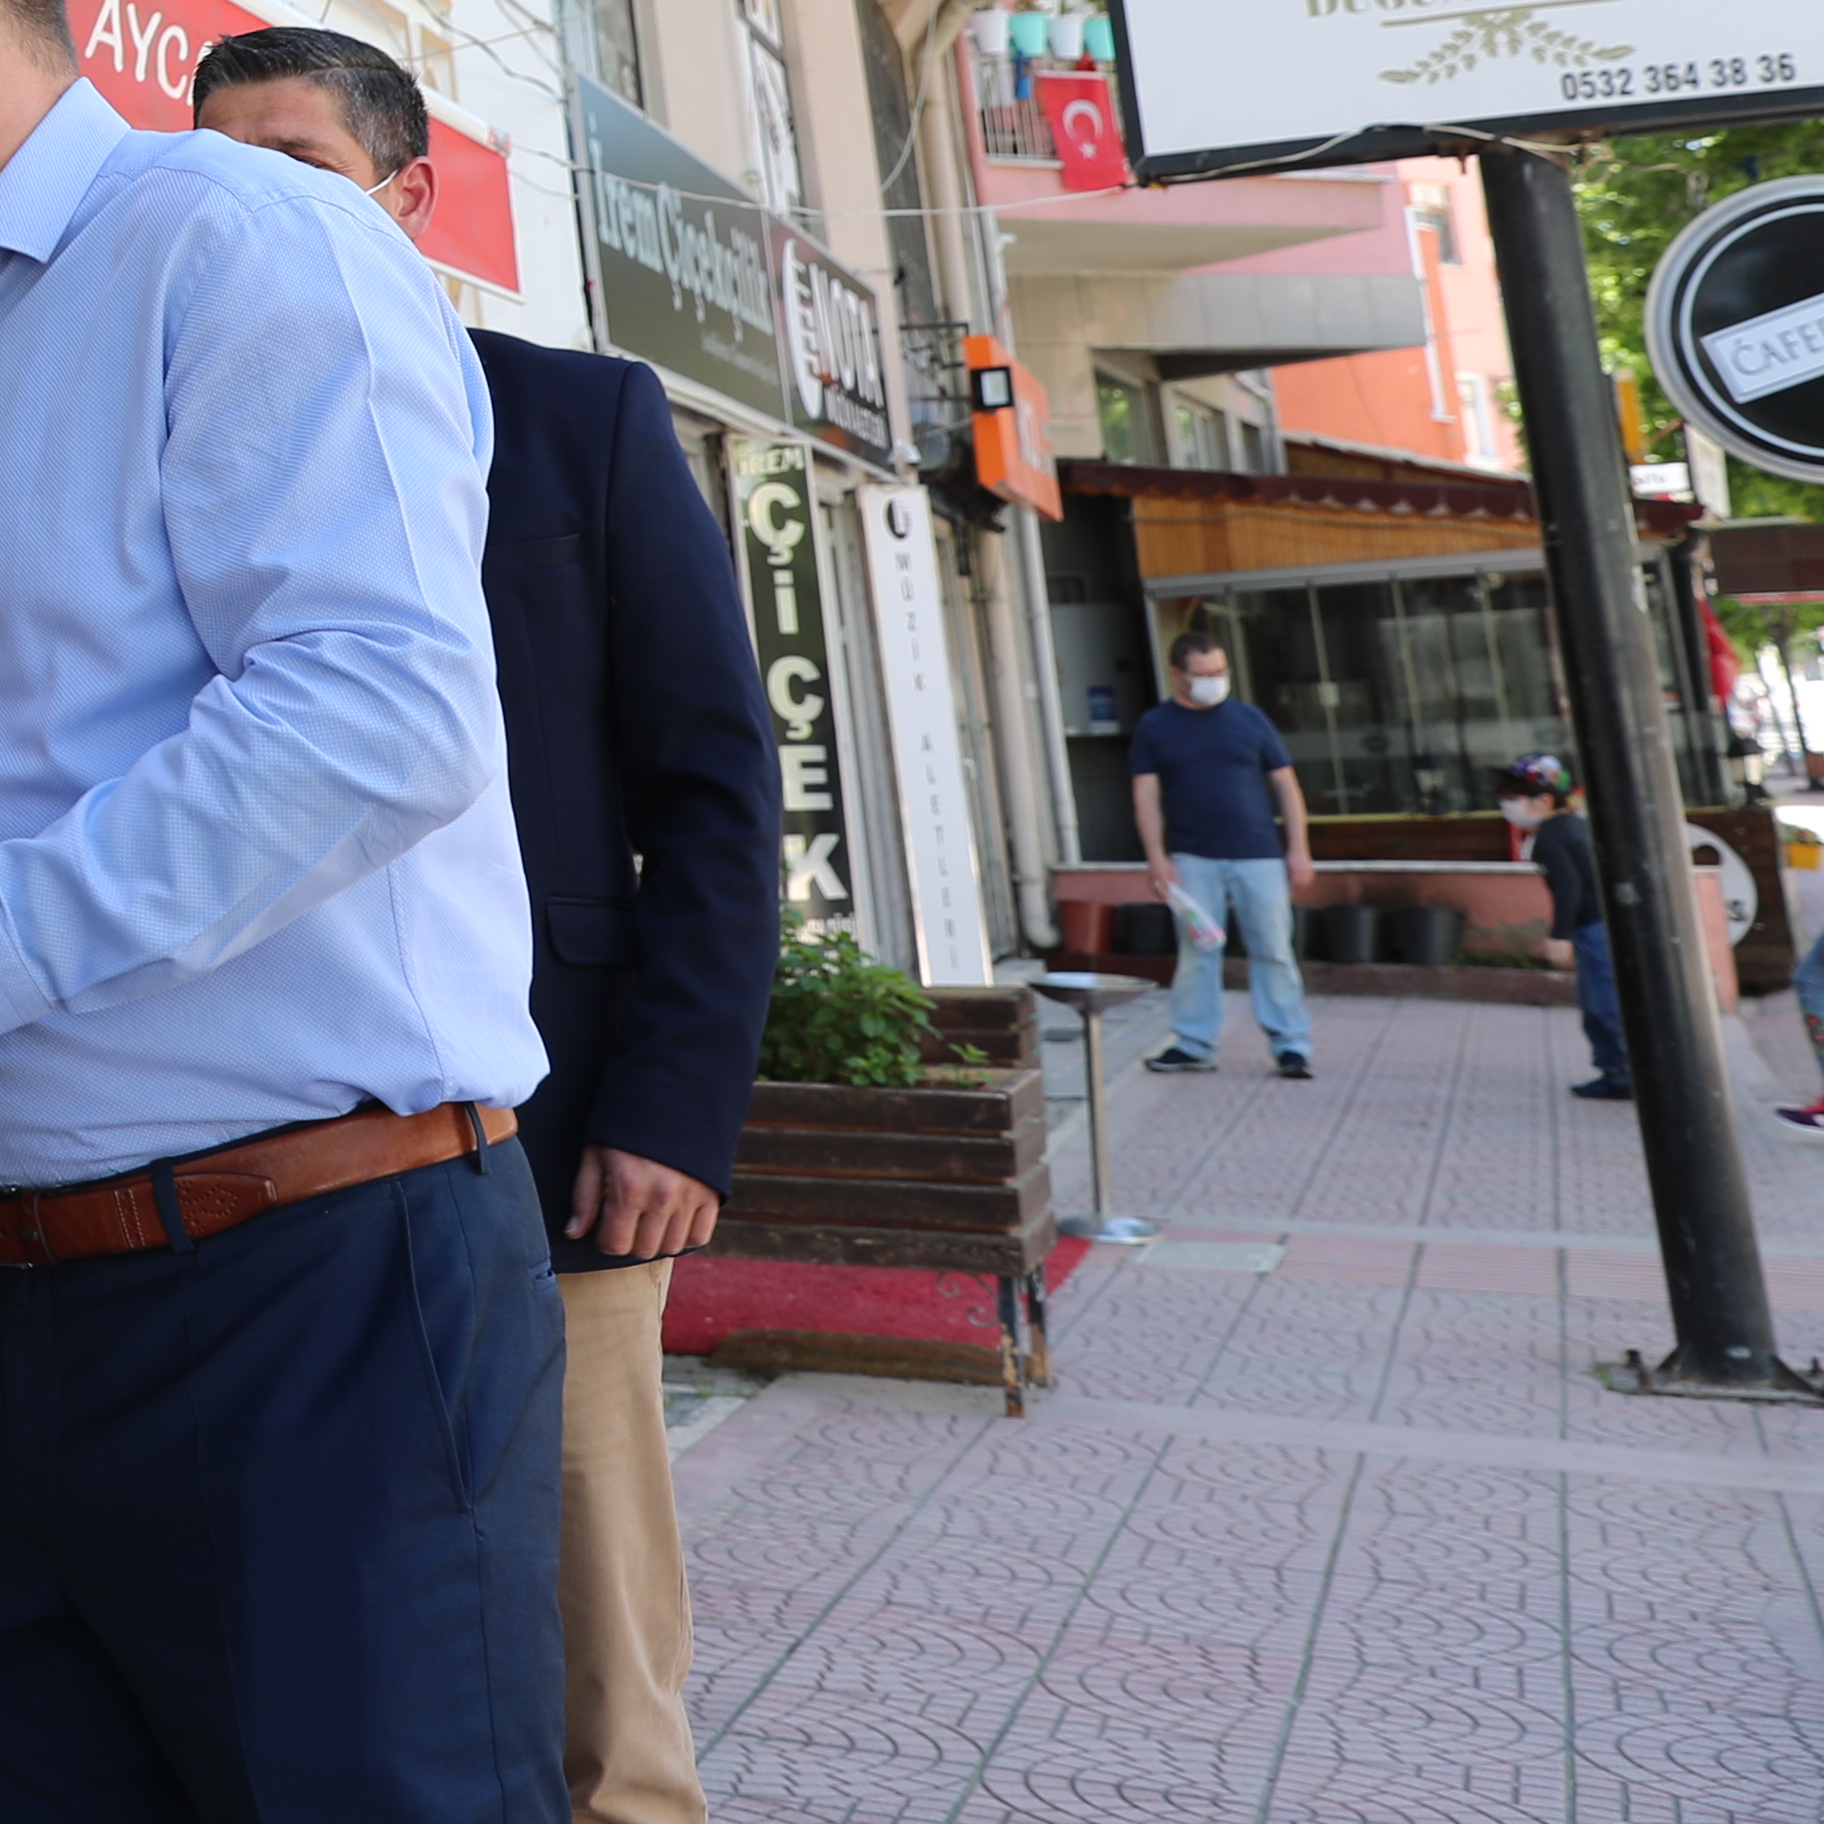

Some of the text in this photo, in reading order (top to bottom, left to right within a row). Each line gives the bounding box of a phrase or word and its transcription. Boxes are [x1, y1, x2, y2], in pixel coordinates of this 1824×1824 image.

[1560, 52, 1798, 101] 0532 364 38 36
